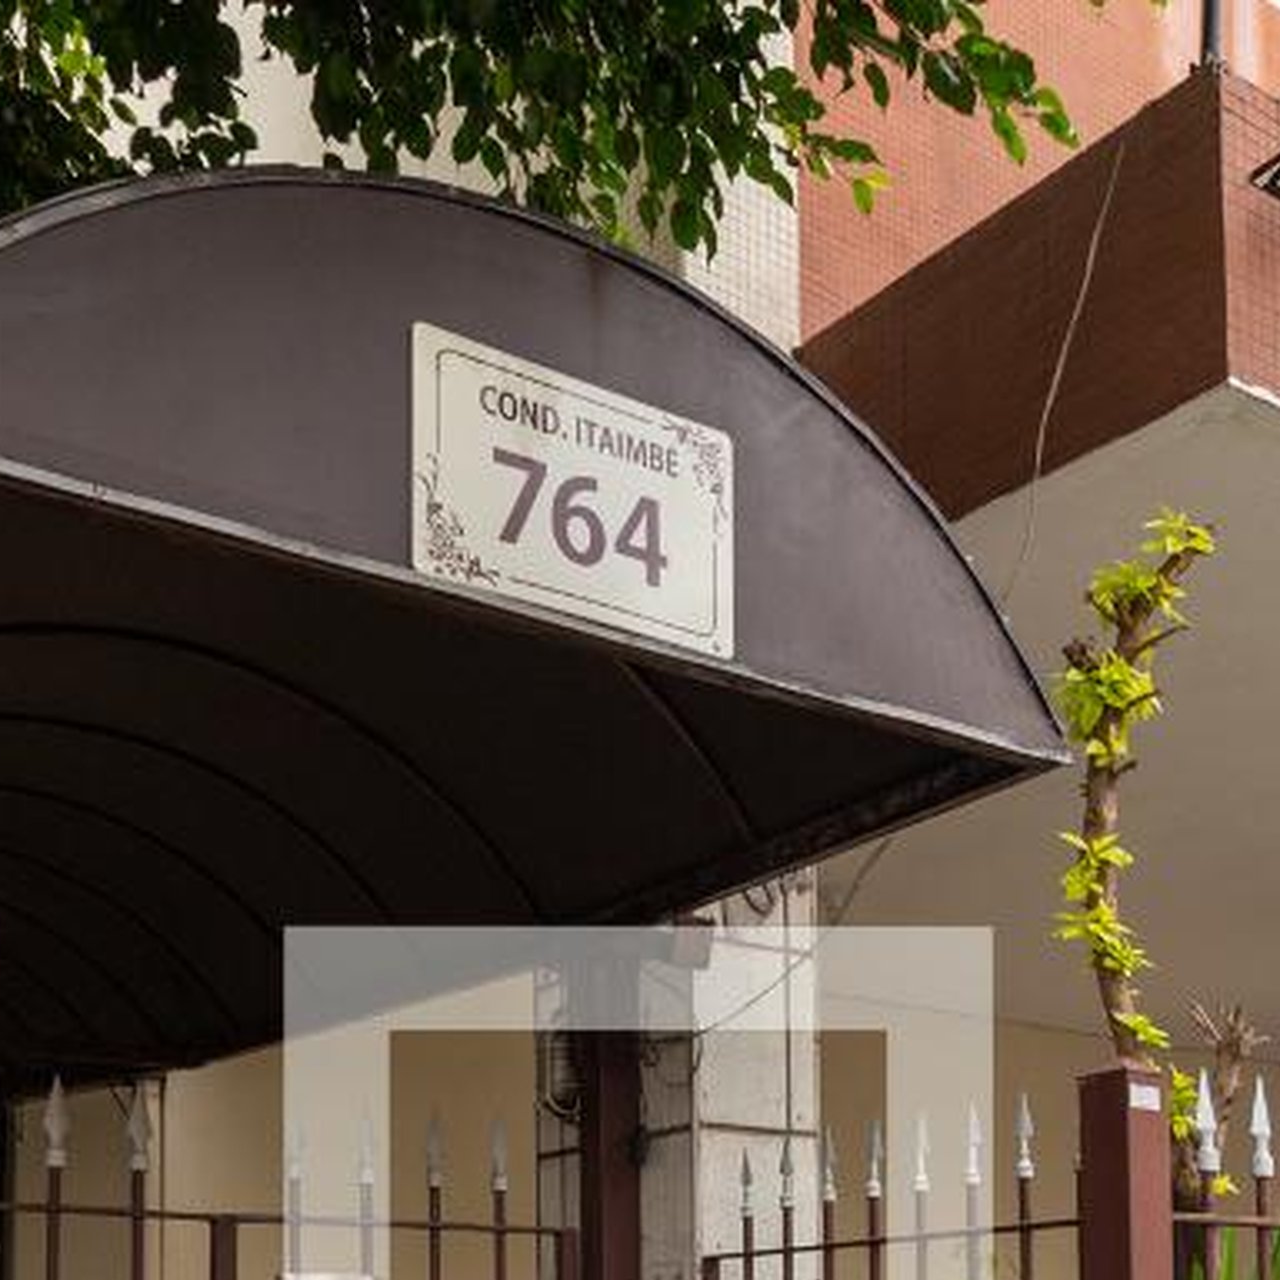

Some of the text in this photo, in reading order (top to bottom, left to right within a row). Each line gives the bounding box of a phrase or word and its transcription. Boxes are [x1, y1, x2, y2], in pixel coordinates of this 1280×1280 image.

[479, 385, 680, 478] COND. ITAIMBE
[491, 446, 668, 588] 764
